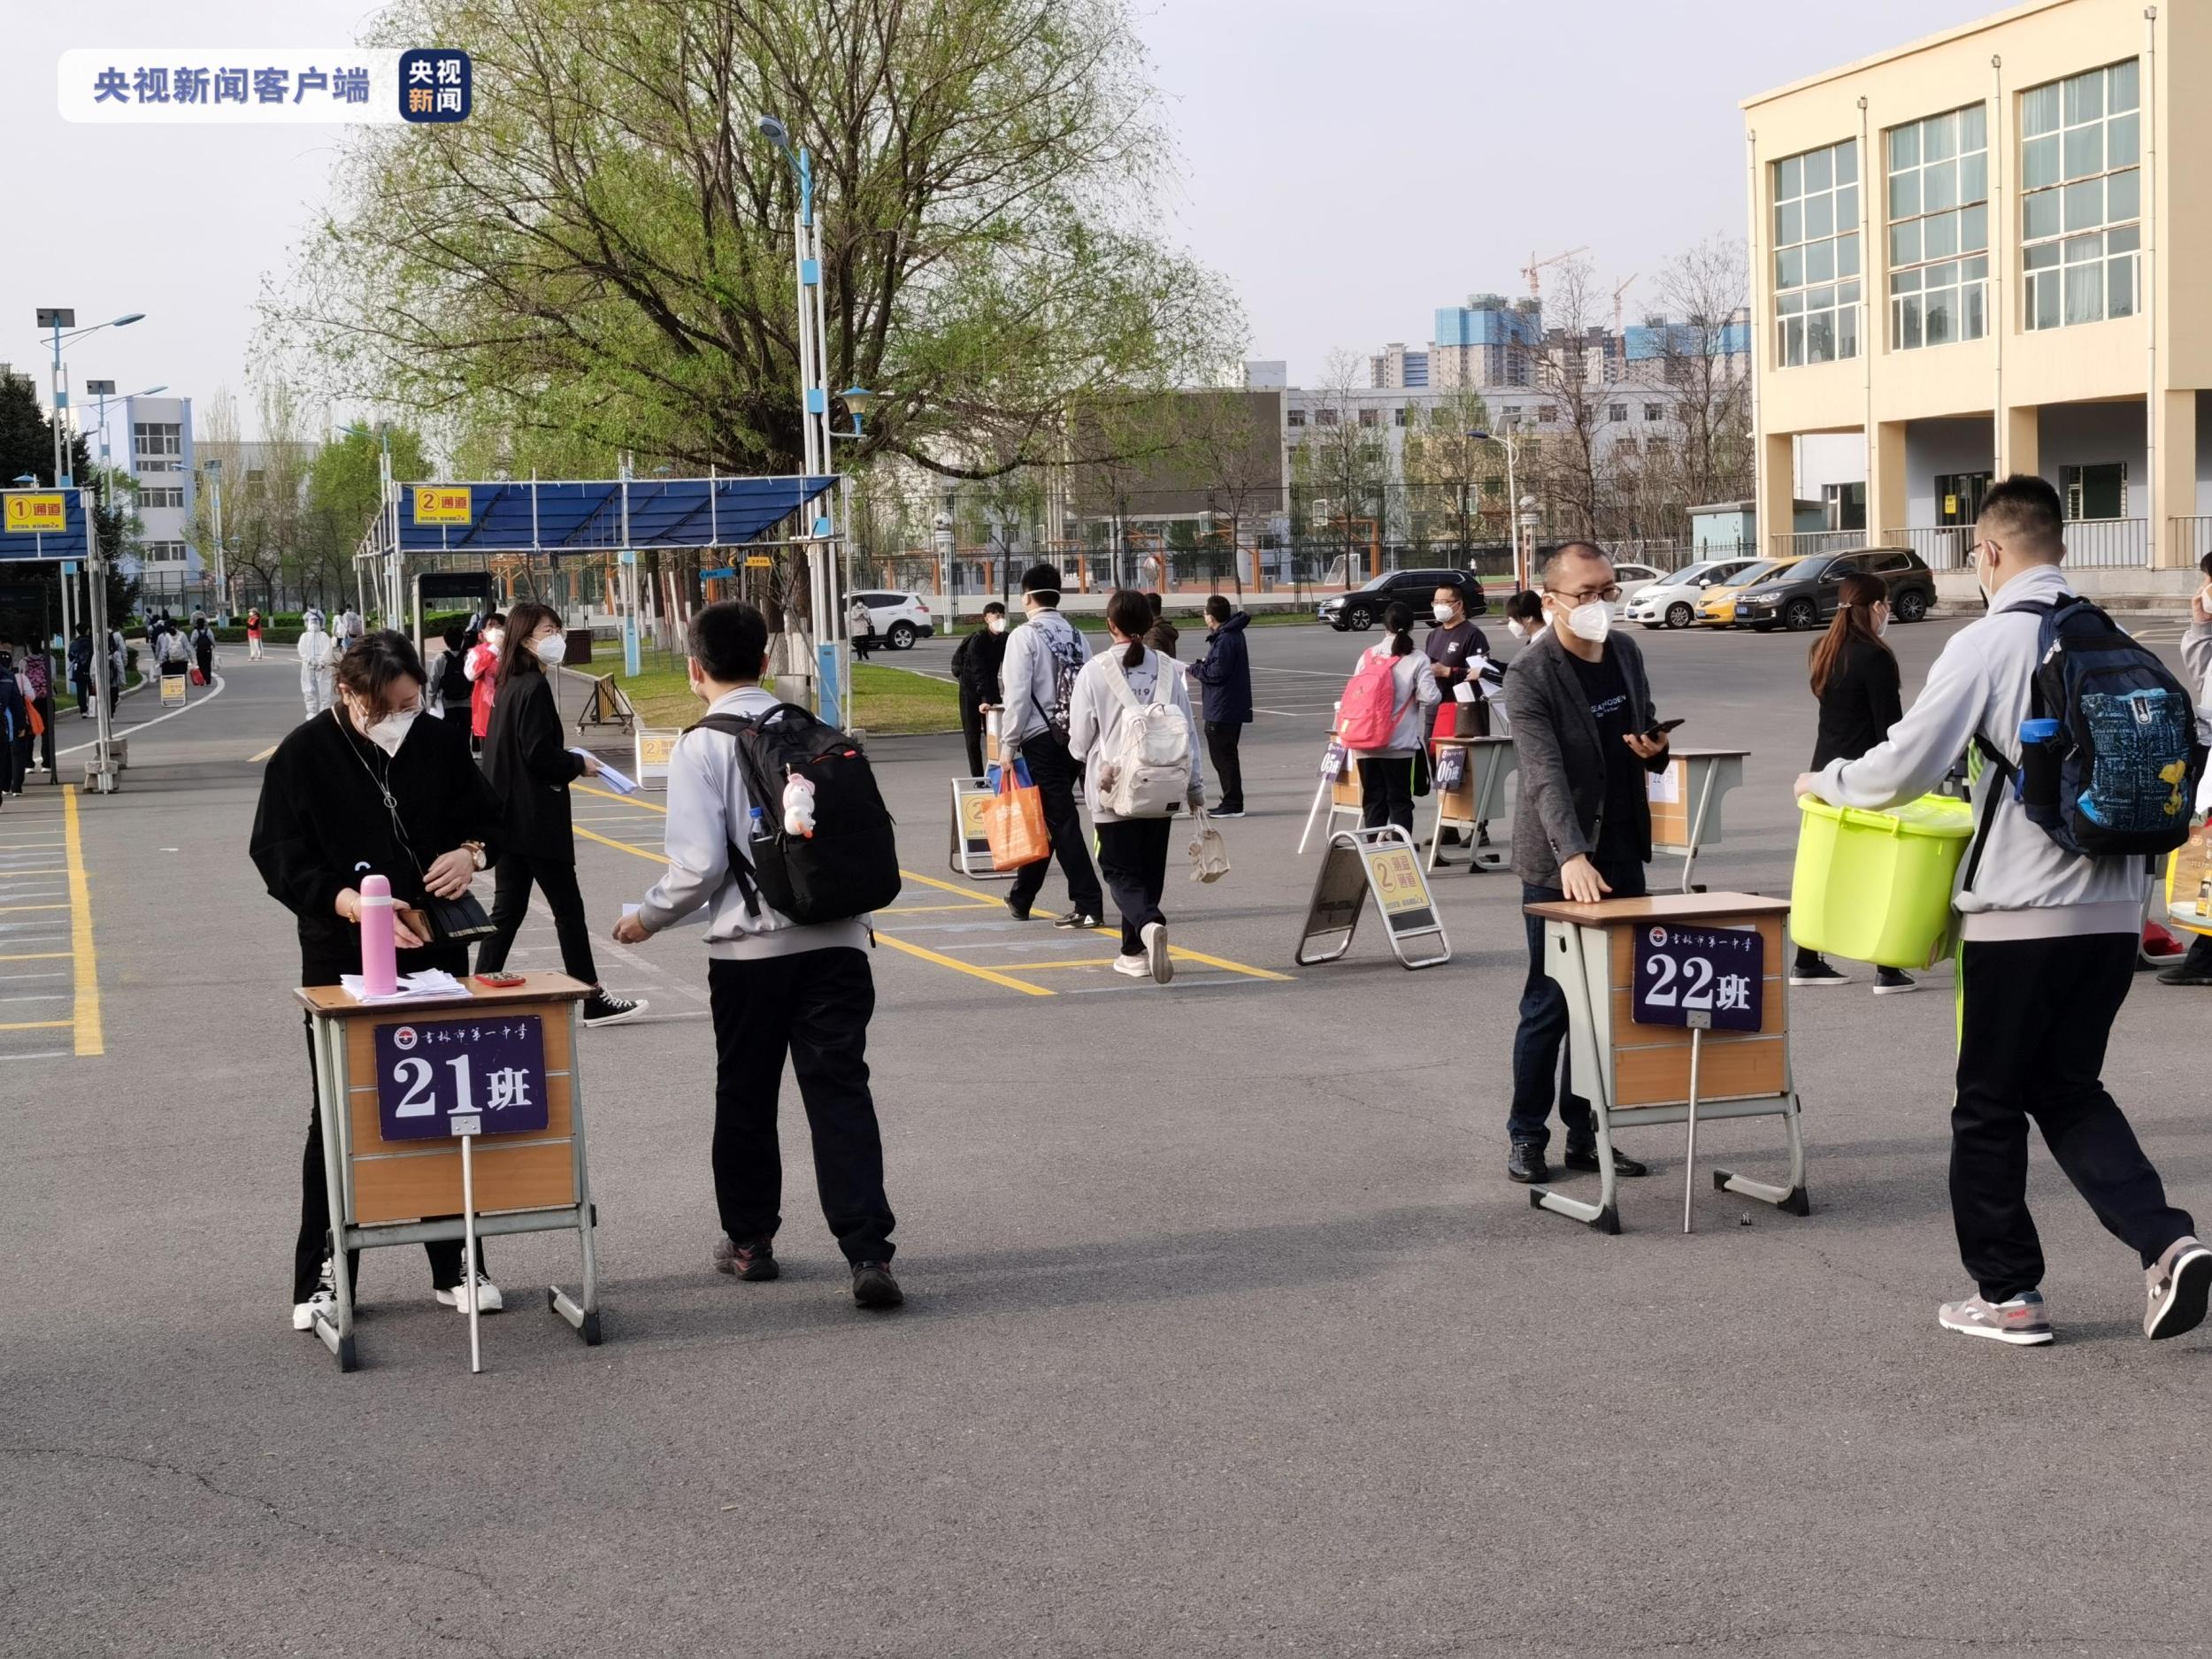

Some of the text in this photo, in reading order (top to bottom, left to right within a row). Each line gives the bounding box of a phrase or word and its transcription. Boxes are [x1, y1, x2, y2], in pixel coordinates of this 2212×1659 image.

[34, 503, 61, 516] 通道
[442, 496, 467, 509] 通道
[1437, 760, 1460, 782] 06班
[1645, 954, 1751, 1010] 22班
[393, 1054, 533, 1118] 21班
